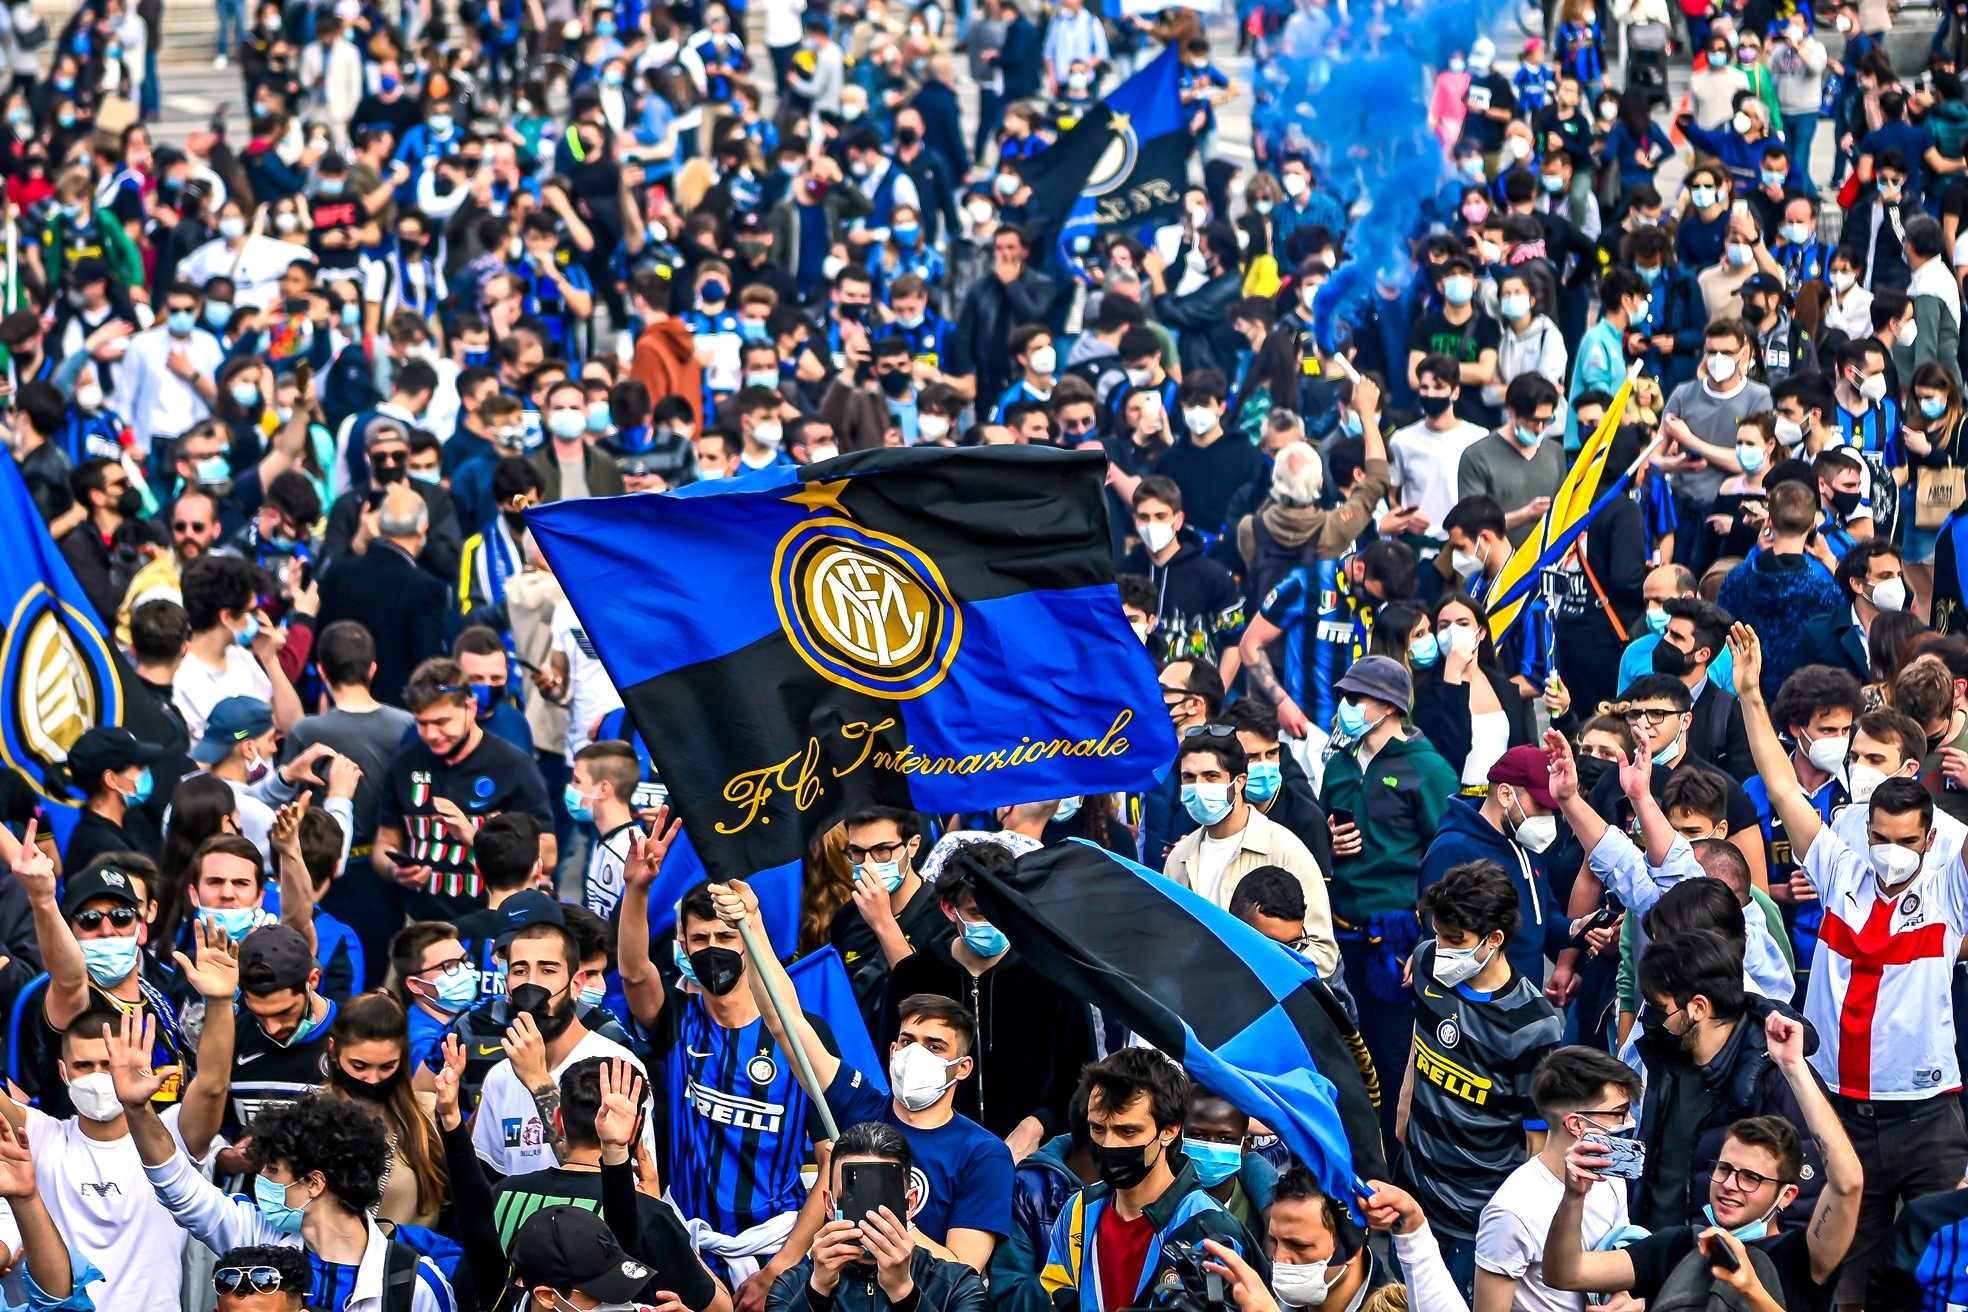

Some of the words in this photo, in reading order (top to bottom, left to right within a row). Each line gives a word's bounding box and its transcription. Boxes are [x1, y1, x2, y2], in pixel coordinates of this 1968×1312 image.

[832, 708, 1133, 778] Internazionale
[1415, 1034, 1492, 1106] RELLI
[504, 1124, 521, 1141] LT
